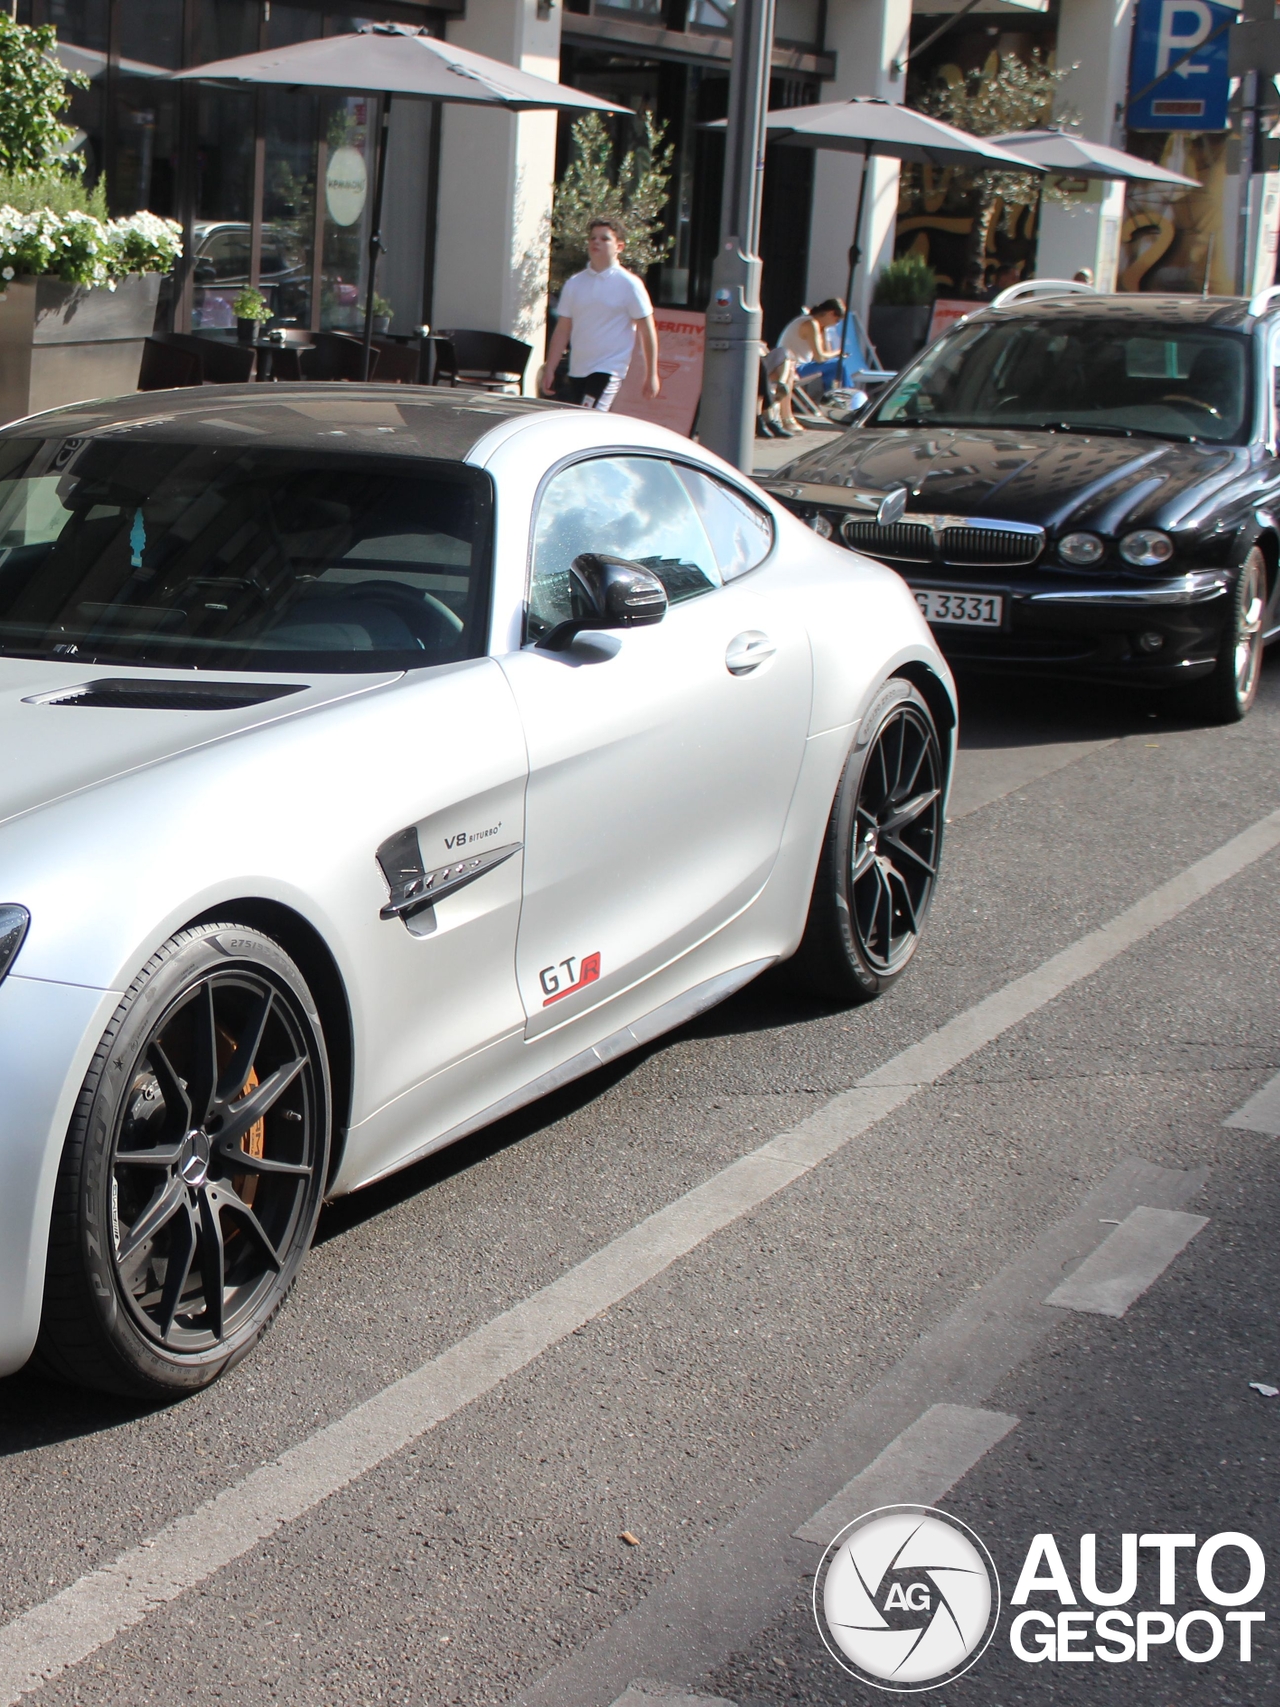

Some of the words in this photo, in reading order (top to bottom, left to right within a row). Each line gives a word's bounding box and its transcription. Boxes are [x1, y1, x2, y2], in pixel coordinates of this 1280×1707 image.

[1155, 0, 1213, 79] P
[935, 595, 997, 623] 3331
[444, 832, 467, 850] V8
